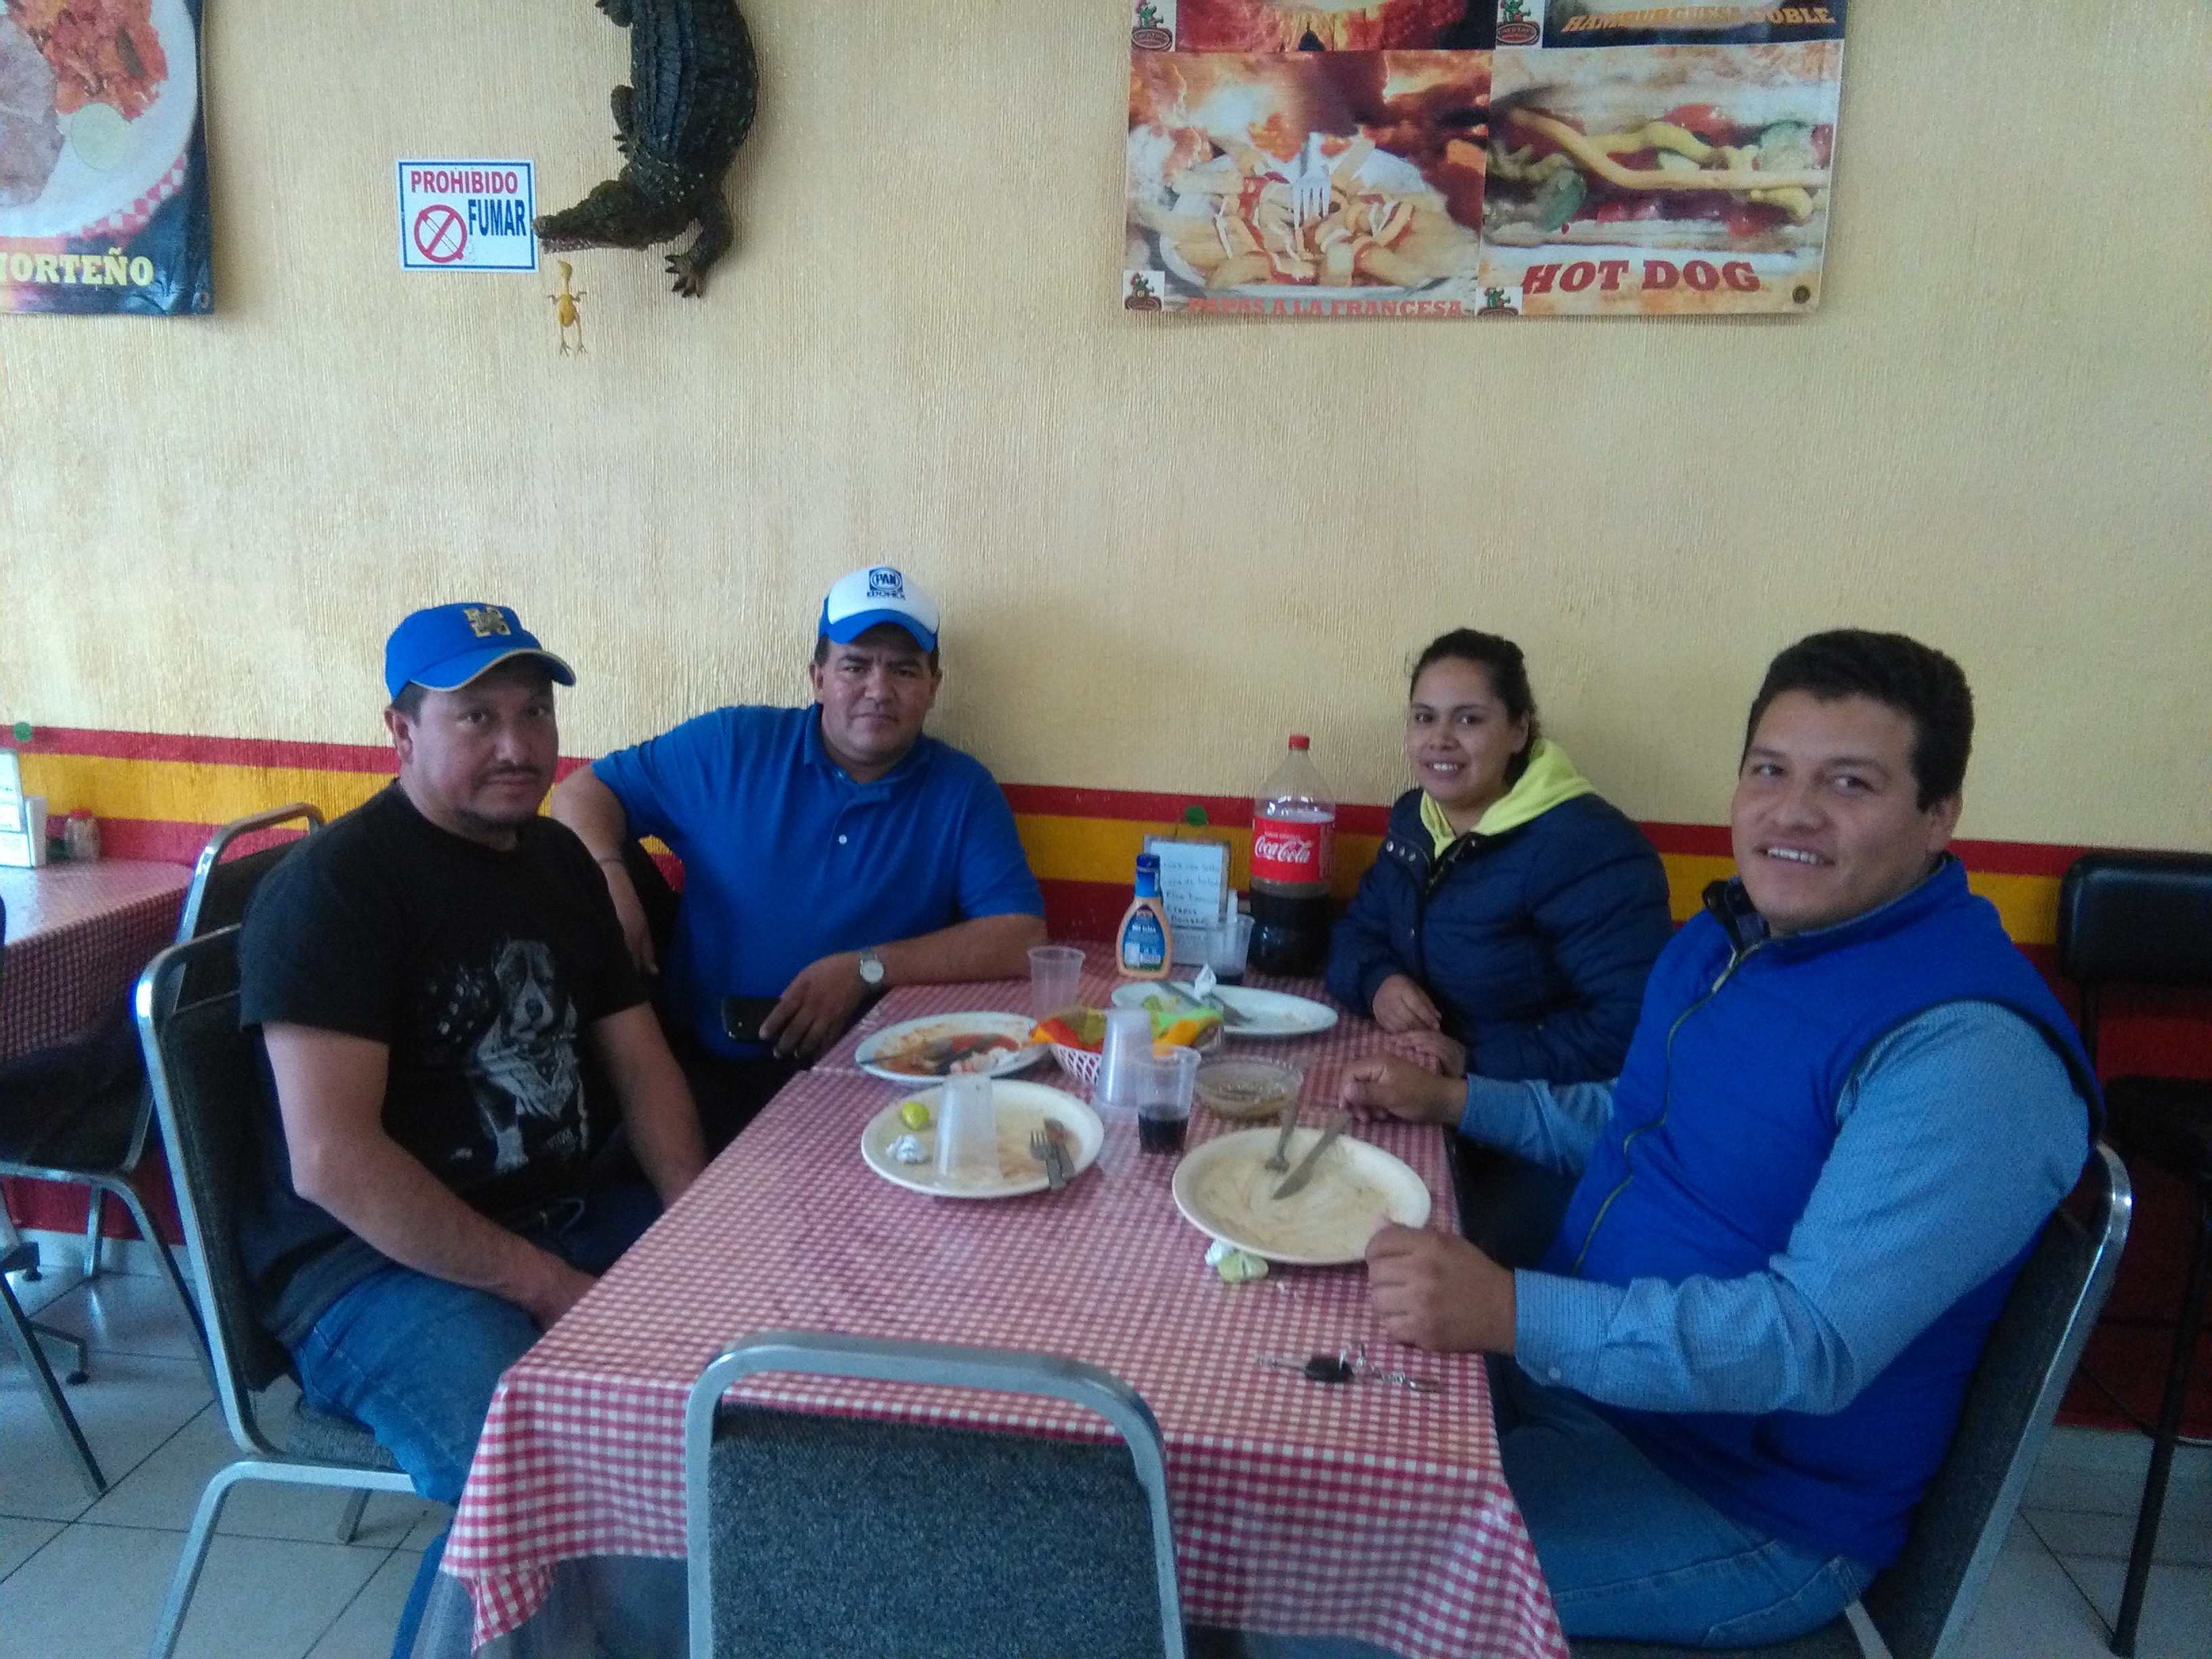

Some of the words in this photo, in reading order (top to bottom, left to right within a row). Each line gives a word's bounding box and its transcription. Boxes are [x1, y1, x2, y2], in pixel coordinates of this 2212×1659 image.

[411, 170, 518, 194] PROHIBIDO
[468, 199, 527, 237] FUMAR
[1522, 260, 1629, 294] HOT
[1641, 260, 1761, 292] DOG
[1188, 297, 1265, 315] PAPAS
[1271, 298, 1288, 315] A
[1293, 299, 1324, 315] LA
[1331, 300, 1462, 318] FRANCESA
[876, 573, 896, 585] PAN
